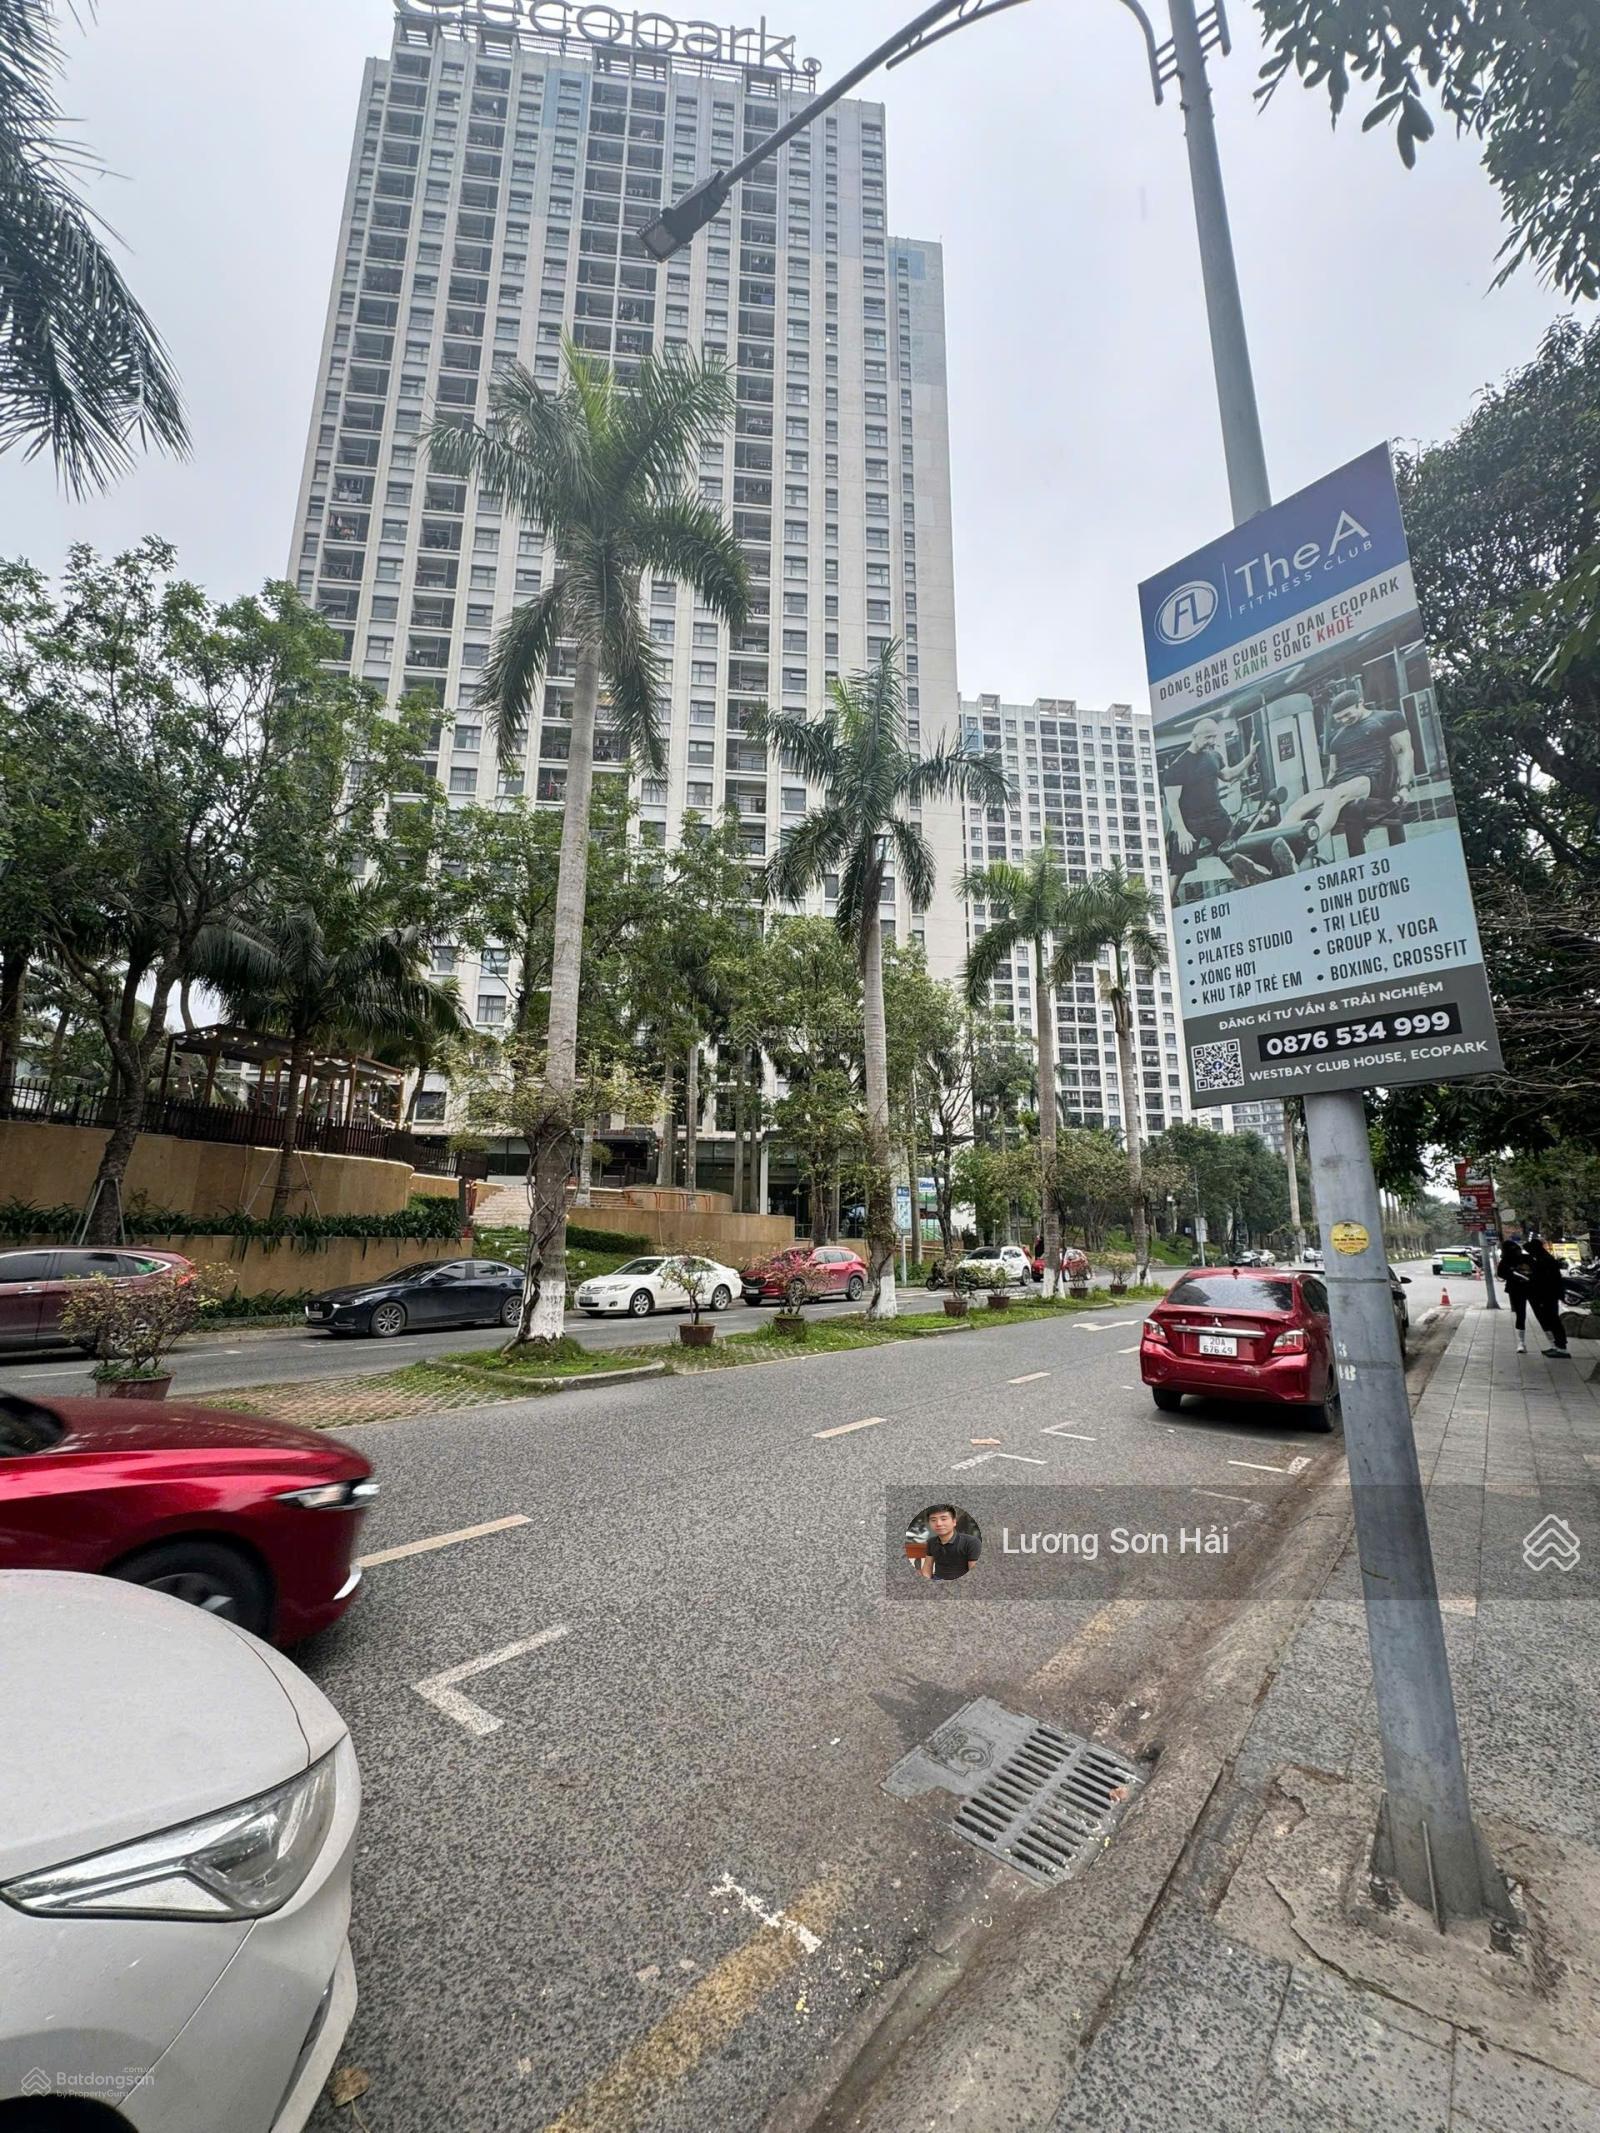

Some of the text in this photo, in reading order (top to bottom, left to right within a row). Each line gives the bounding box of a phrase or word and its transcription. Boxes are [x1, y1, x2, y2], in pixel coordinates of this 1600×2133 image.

[1239, 540, 1373, 615] FITNESS CLUB
[1331, 576, 1400, 620] ECOPARK
[1234, 655, 1269, 681] XANH
[1317, 857, 1391, 891] SMART 30
[1320, 891, 1354, 914] DINH
[1323, 906, 1381, 934] TRỊ LIỆU
[1196, 925, 1222, 945] GYM
[1198, 929, 1293, 966] PILATES STUDIO
[1327, 916, 1439, 956] GROUP X, YOGA
[1330, 938, 1468, 982] BOXING, CROSSFIT
[1202, 987, 1226, 1005] KHU
[1282, 970, 1303, 989] EM
[1218, 1013, 1256, 1031] ĐĂNG
[1273, 1006, 1292, 1021] TƯ
[1328, 1000, 1340, 1012] &
[1340, 991, 1377, 1010] TRẢI
[1379, 981, 1444, 1004] NGHIỆM
[1266, 1010, 1451, 1056] 0876 534 999
[1249, 1040, 1489, 1082] WESTBAY CLUB HOUSE, ECOPARK
[1209, 1337, 1226, 1347] 20A
